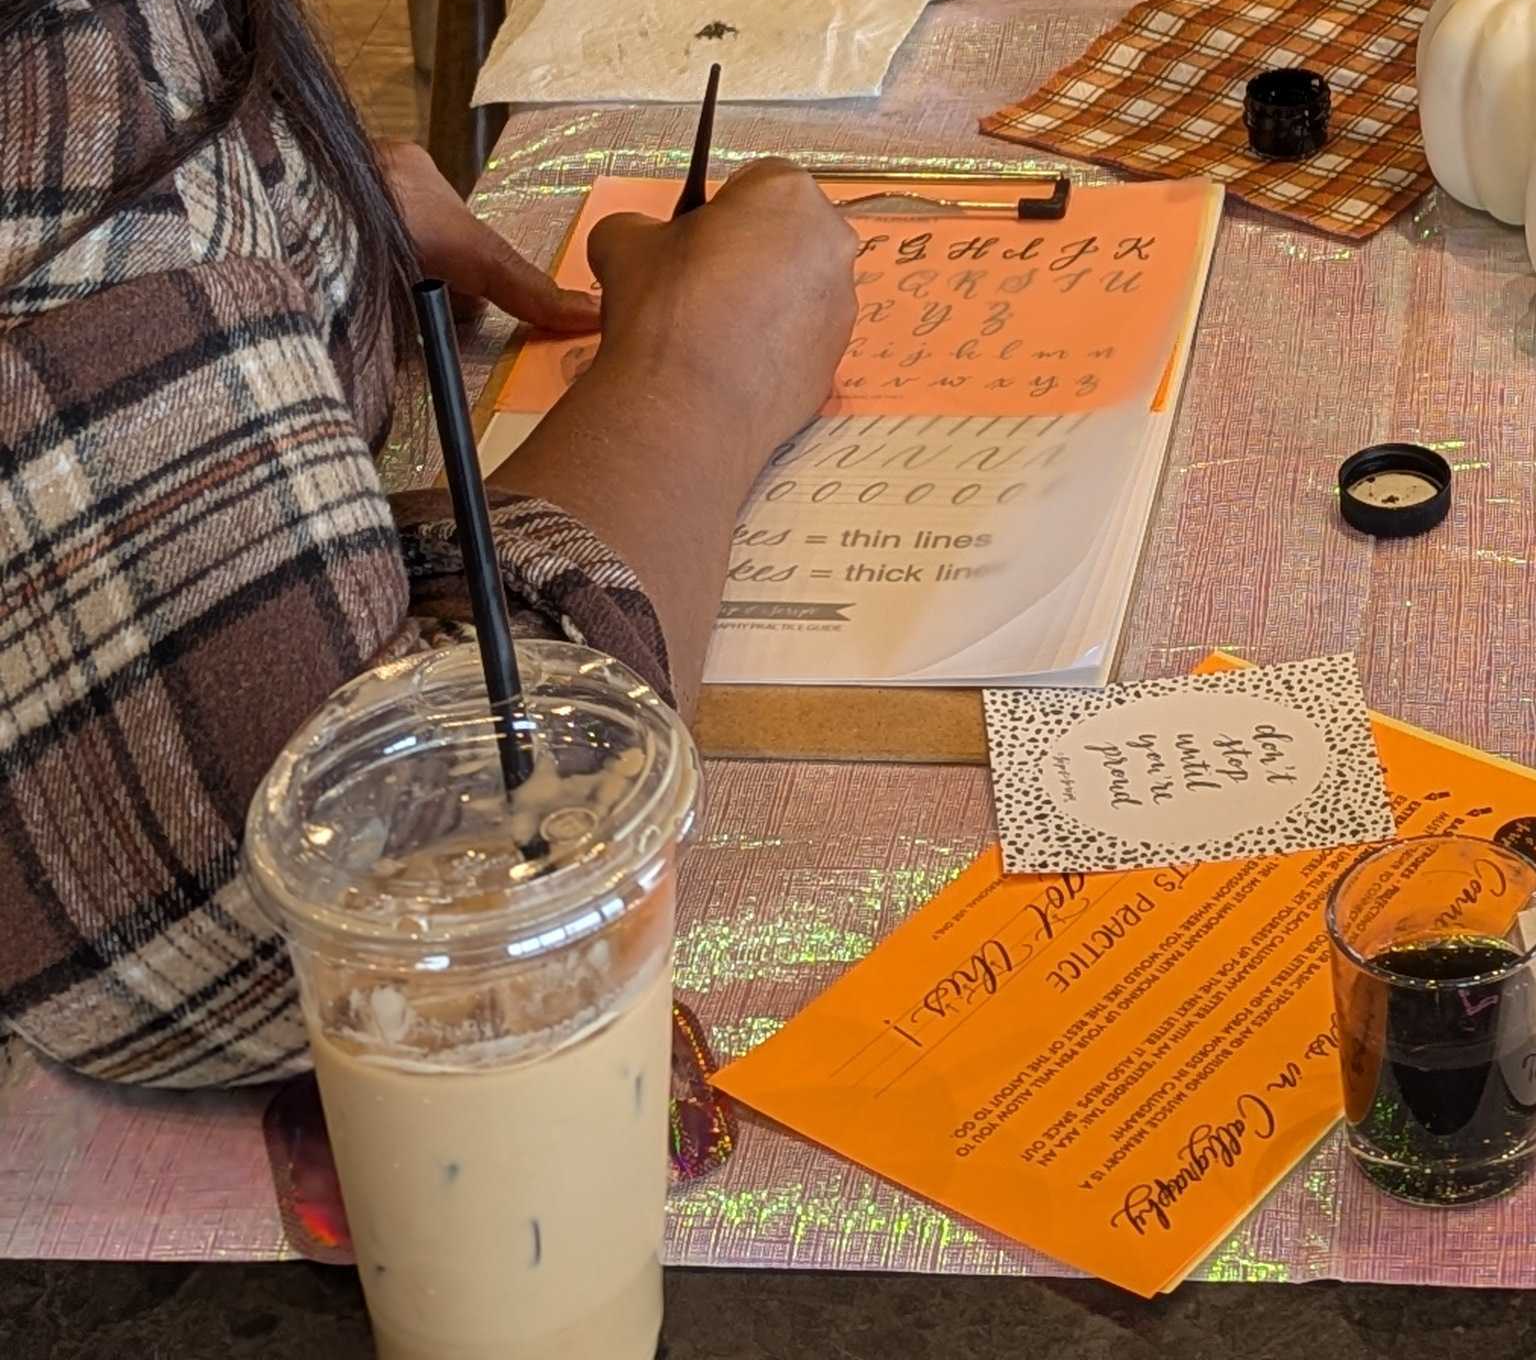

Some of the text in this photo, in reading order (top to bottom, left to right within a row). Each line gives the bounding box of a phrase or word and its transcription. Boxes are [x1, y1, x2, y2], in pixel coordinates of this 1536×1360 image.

[840, 529, 993, 550] thin lines
[844, 563, 923, 583] thick
[1126, 732, 1175, 806] you're
[1173, 732, 1222, 792] until
[1211, 732, 1250, 784] stop
[1250, 723, 1297, 785] don't
[1083, 741, 1142, 809] proud
[1043, 888, 1157, 995] PRACTICE
[1157, 928, 1184, 954] YOU
[1268, 951, 1308, 990] LETTERS
[1248, 984, 1273, 1010] AND
[1073, 1019, 1106, 1052] YOUR
[1220, 1005, 1253, 1037] FORM
[1227, 1025, 1254, 1051] AND
[1104, 1053, 1135, 1084] ALSO
[1183, 1031, 1225, 1073] WORDS
[987, 1067, 1031, 1111] LAYOUT
[1040, 1106, 1078, 1144] SPACE
[1108, 1077, 1176, 1145] CALLIGRAPHY
[1144, 1088, 1188, 1132] MUSCLE
[953, 1138, 976, 1161] TO
[971, 1118, 998, 1145] YOU
[1018, 1136, 1046, 1164] OUT
[1101, 1124, 1149, 1173] MEMORY
[1111, 1096, 1270, 1234] Calligraphy
